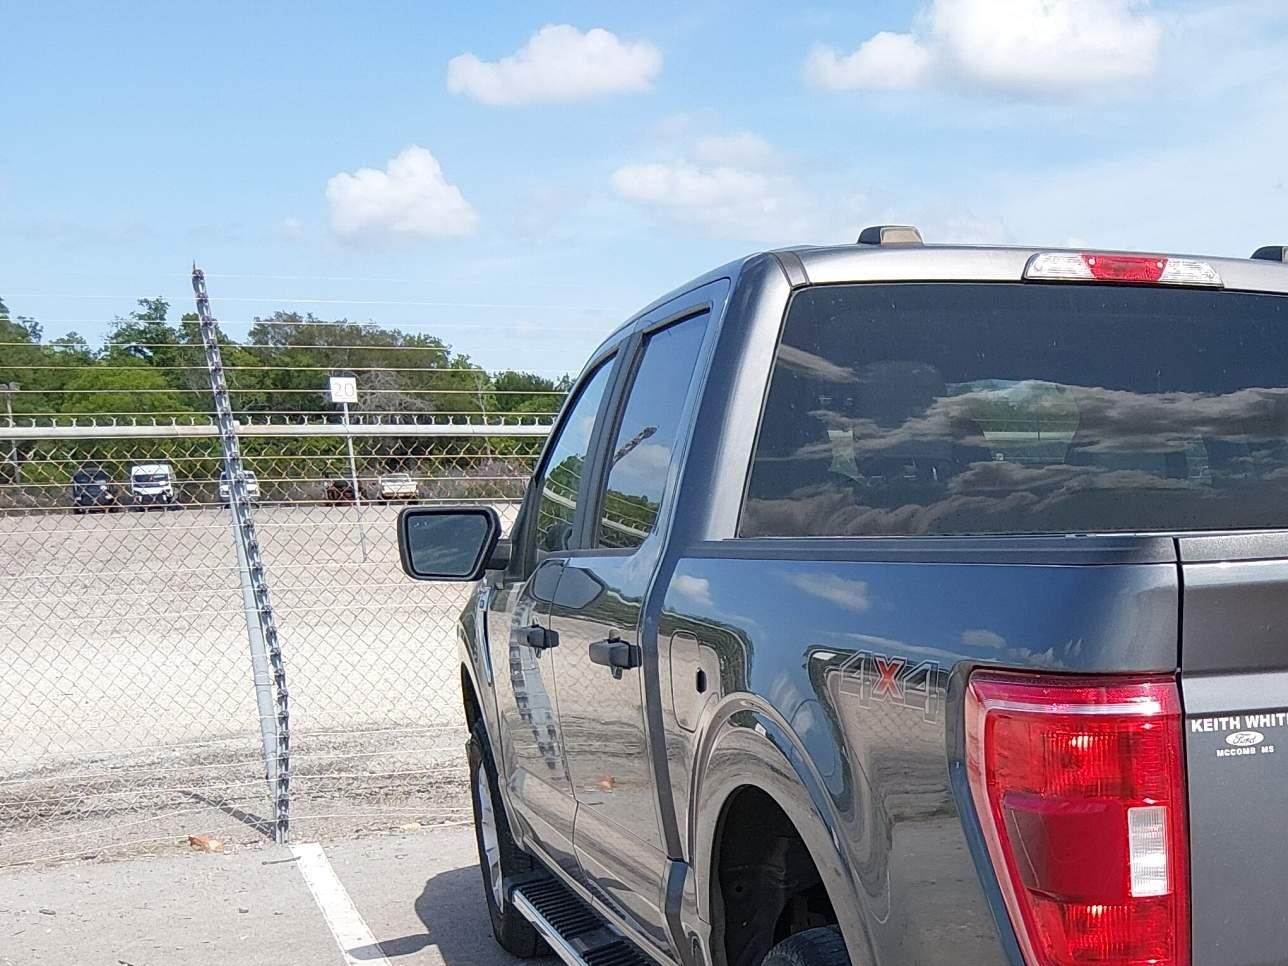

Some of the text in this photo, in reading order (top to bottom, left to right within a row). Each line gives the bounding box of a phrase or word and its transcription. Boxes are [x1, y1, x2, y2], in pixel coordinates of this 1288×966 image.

[1191, 716, 1240, 732] KEITH
[1231, 732, 1258, 745] Ford
[1216, 745, 1275, 757] MCCOMB MS
